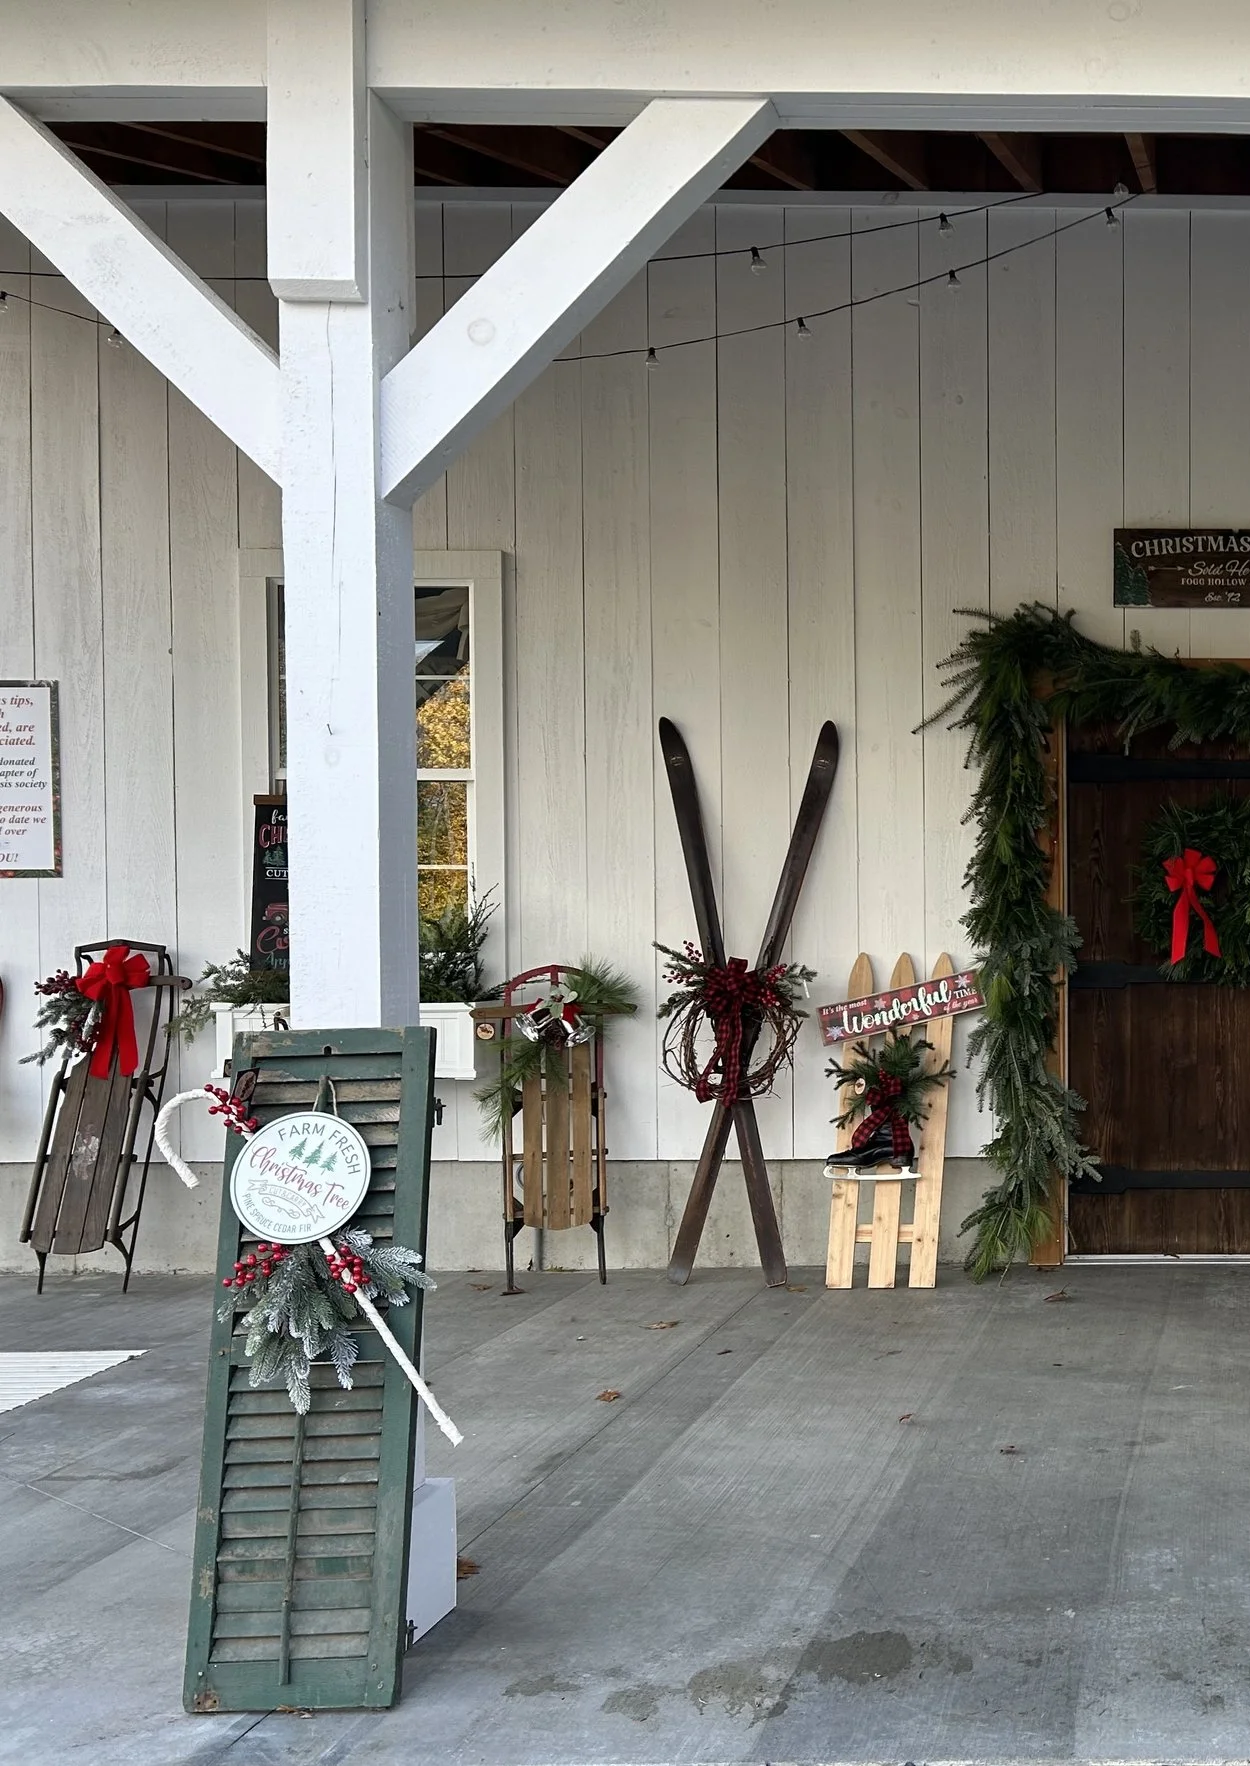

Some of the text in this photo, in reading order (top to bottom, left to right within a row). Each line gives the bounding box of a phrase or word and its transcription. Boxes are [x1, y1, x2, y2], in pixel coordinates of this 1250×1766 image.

[1131, 535, 1250, 558] CHRISTMAS
[1188, 560, 1224, 577] Sold
[1208, 577, 1246, 586] HOLLOW
[10, 695, 34, 709] tips,
[16, 724, 35, 732] are
[27, 768, 39, 779] of
[15, 779, 48, 790] society
[8, 815, 30, 824] date
[33, 816, 47, 824] we
[271, 809, 288, 824] fa
[5, 828, 27, 836] over
[953, 987, 978, 999] TIME
[822, 999, 867, 1016] It's the most
[842, 979, 952, 1034] Wonderful
[952, 1000, 962, 1009] the
[962, 997, 979, 1010] year
[278, 1122, 361, 1175] FARM FRESH
[249, 1144, 350, 1210] Christmas Tree
[241, 1193, 312, 1234] PINE SPRUCE CEDAR FIR
